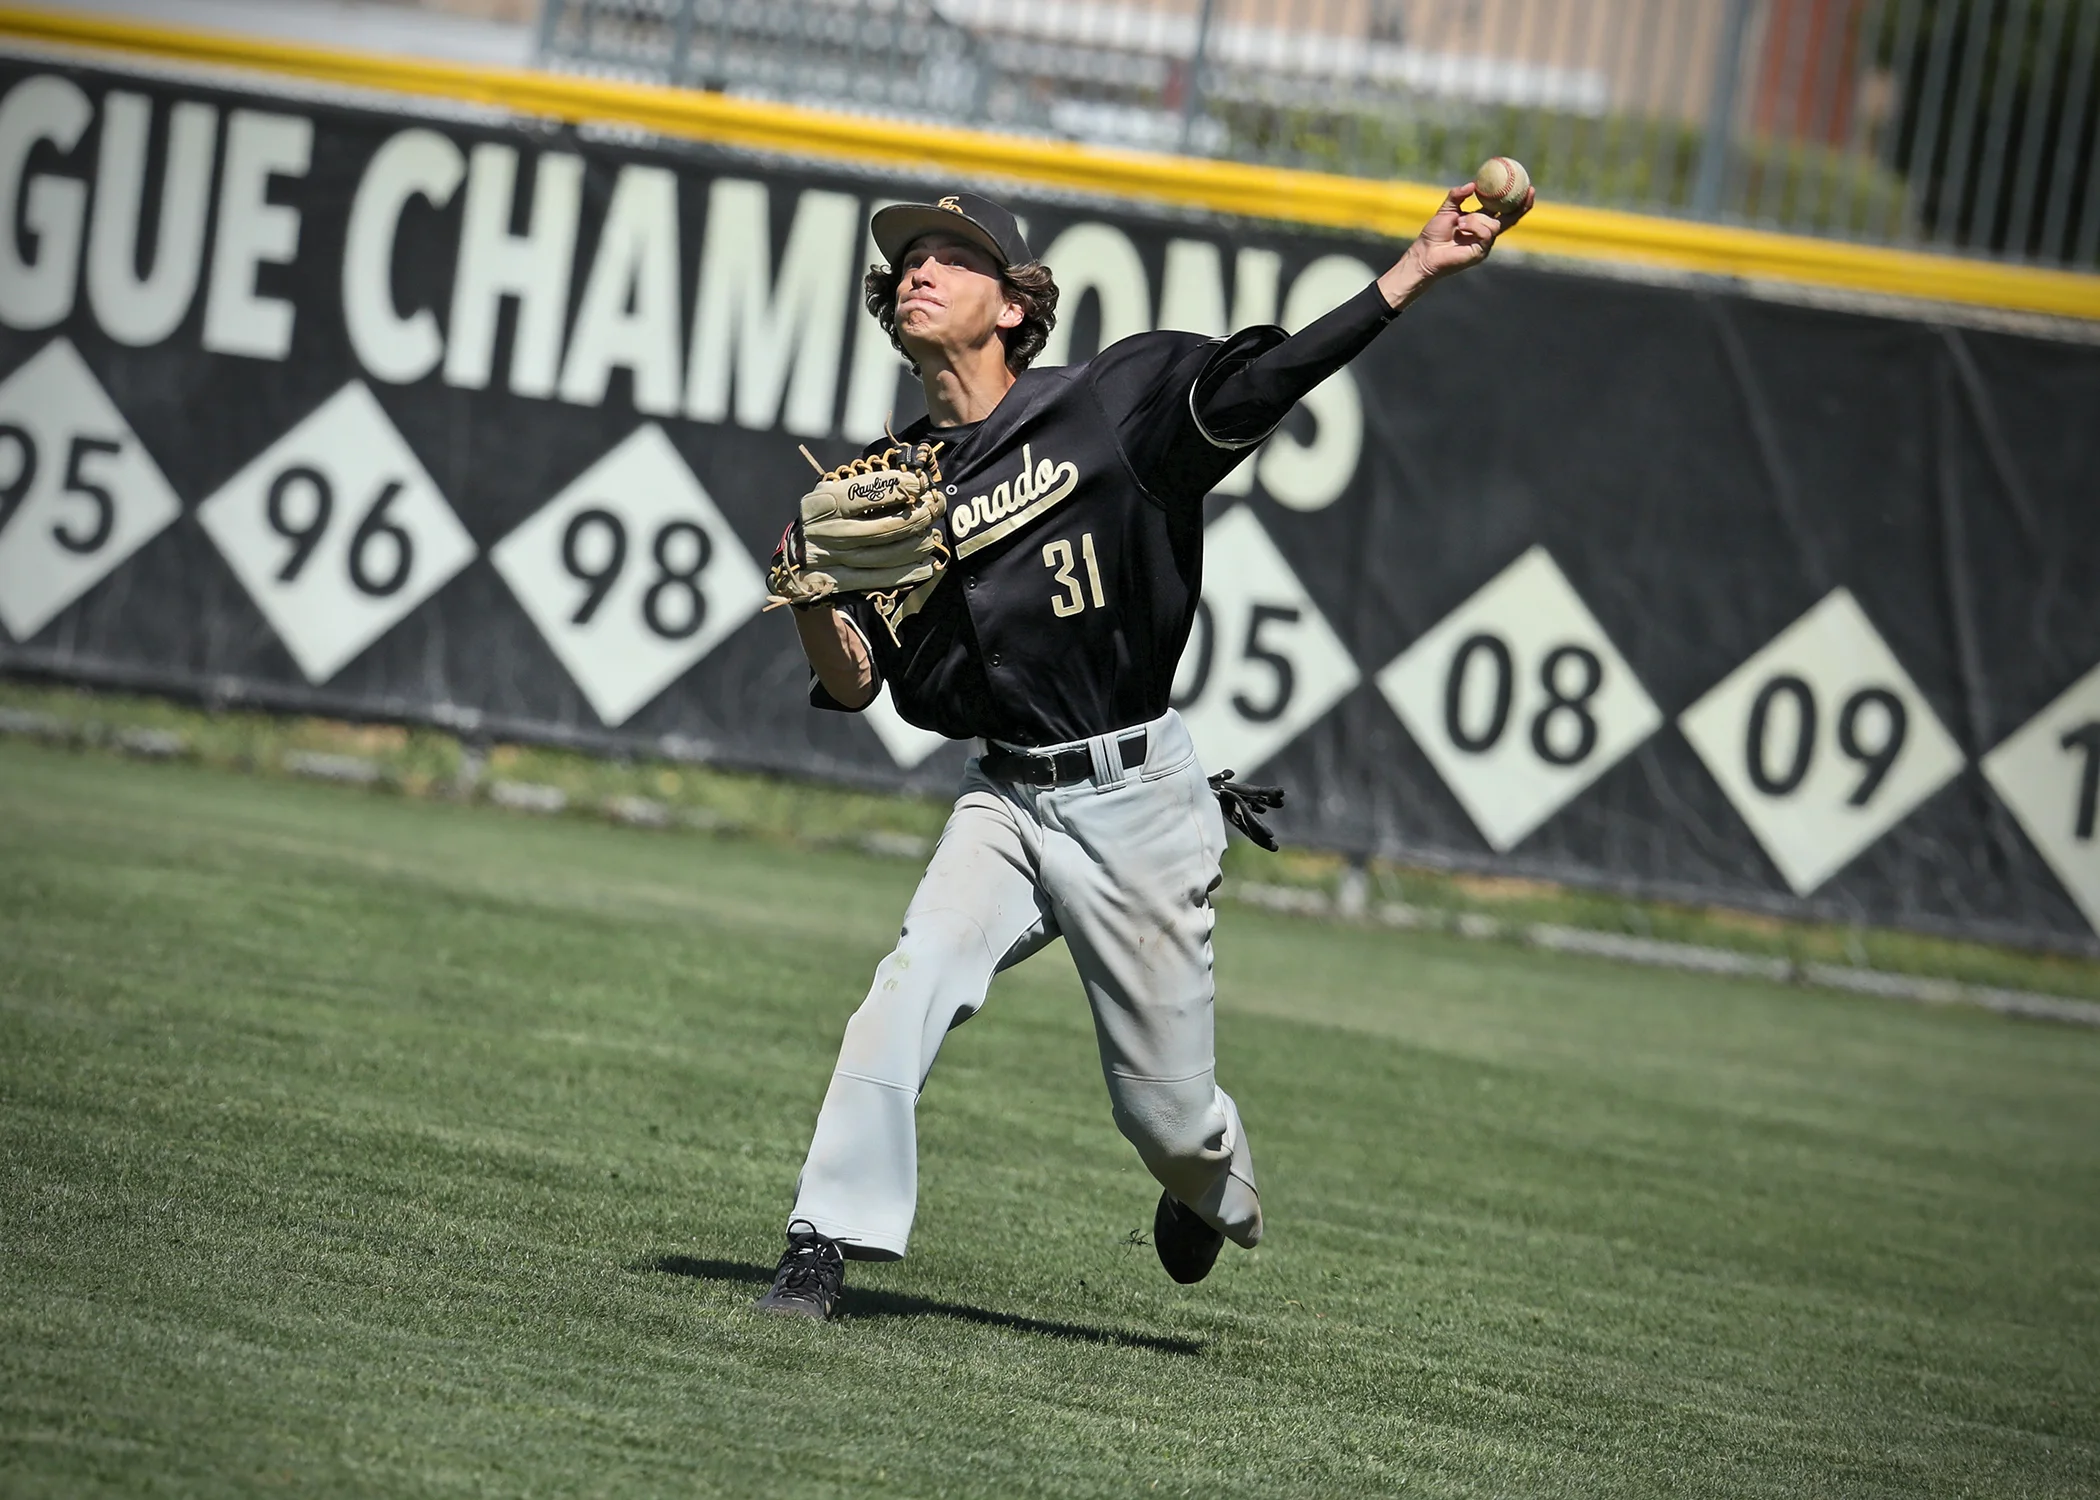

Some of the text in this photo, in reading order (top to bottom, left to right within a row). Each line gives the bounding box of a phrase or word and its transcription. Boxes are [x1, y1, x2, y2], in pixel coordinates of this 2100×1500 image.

[0, 74, 1364, 512] GUE CHAMS
[265, 464, 414, 599] 96
[848, 477, 900, 501] Rawlings
[561, 508, 713, 641] 98
[1042, 533, 1105, 618] 31
[1443, 632, 1605, 768] 08
[1745, 674, 1909, 807] 09
[2062, 721, 2100, 839] 1
